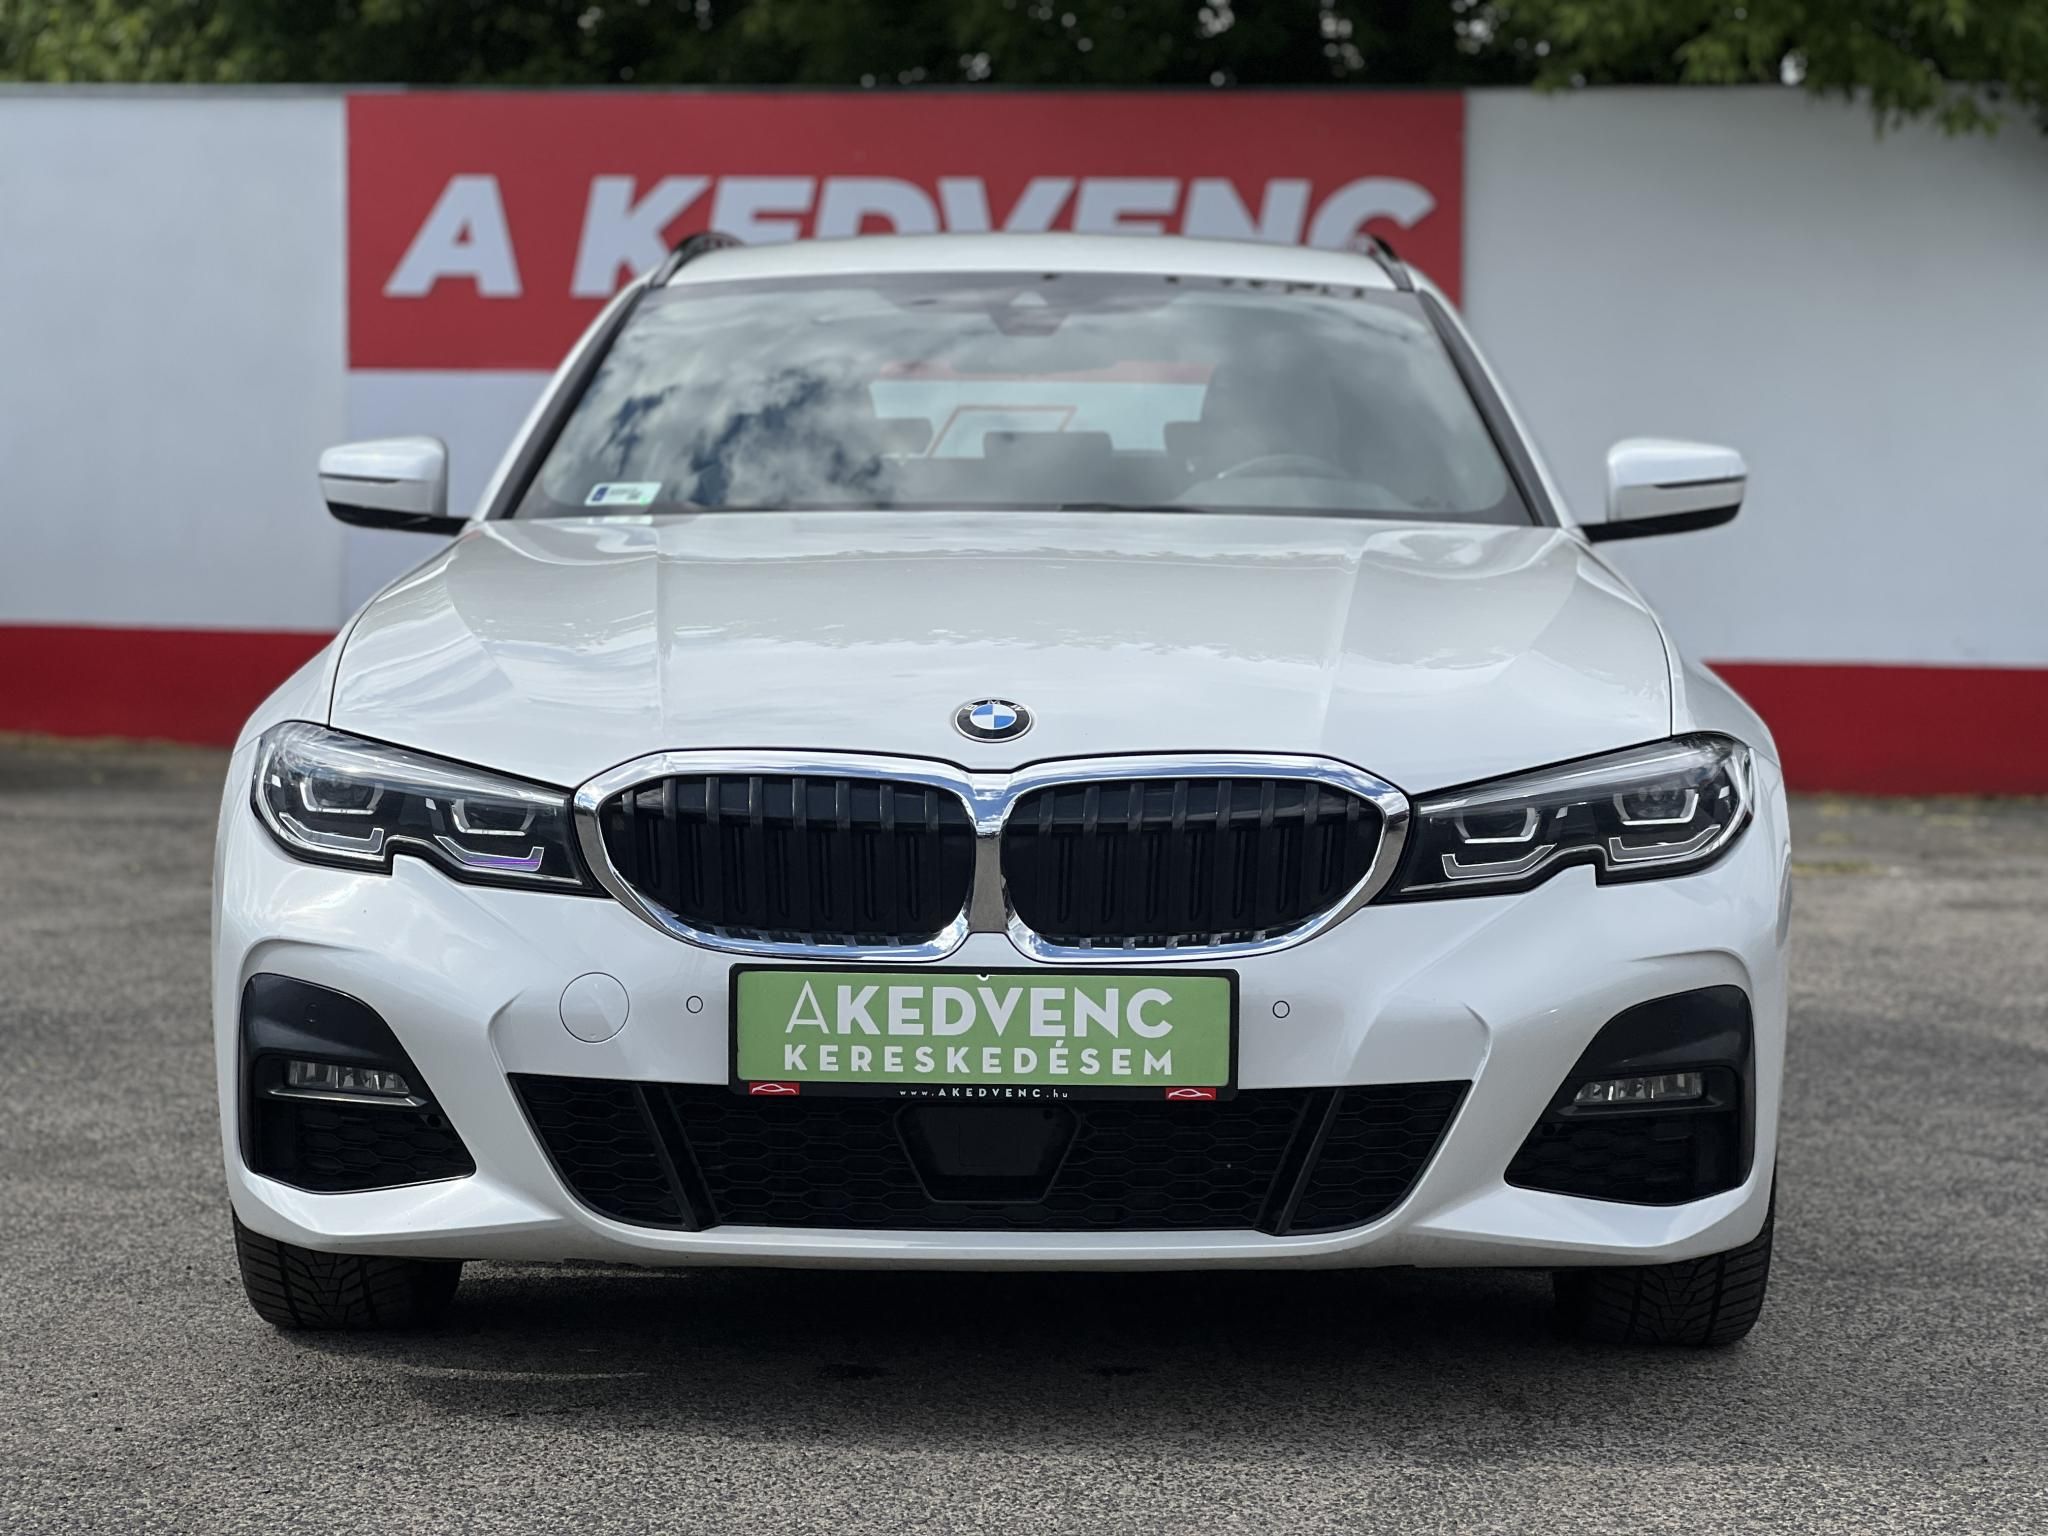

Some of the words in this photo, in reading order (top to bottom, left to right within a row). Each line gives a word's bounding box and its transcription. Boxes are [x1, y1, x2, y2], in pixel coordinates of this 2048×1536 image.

[384, 174, 523, 298] A
[783, 1039, 1173, 1076] KERESKEDÉSEM
[899, 1087, 1069, 1099] www.AKEDVENC.hu
